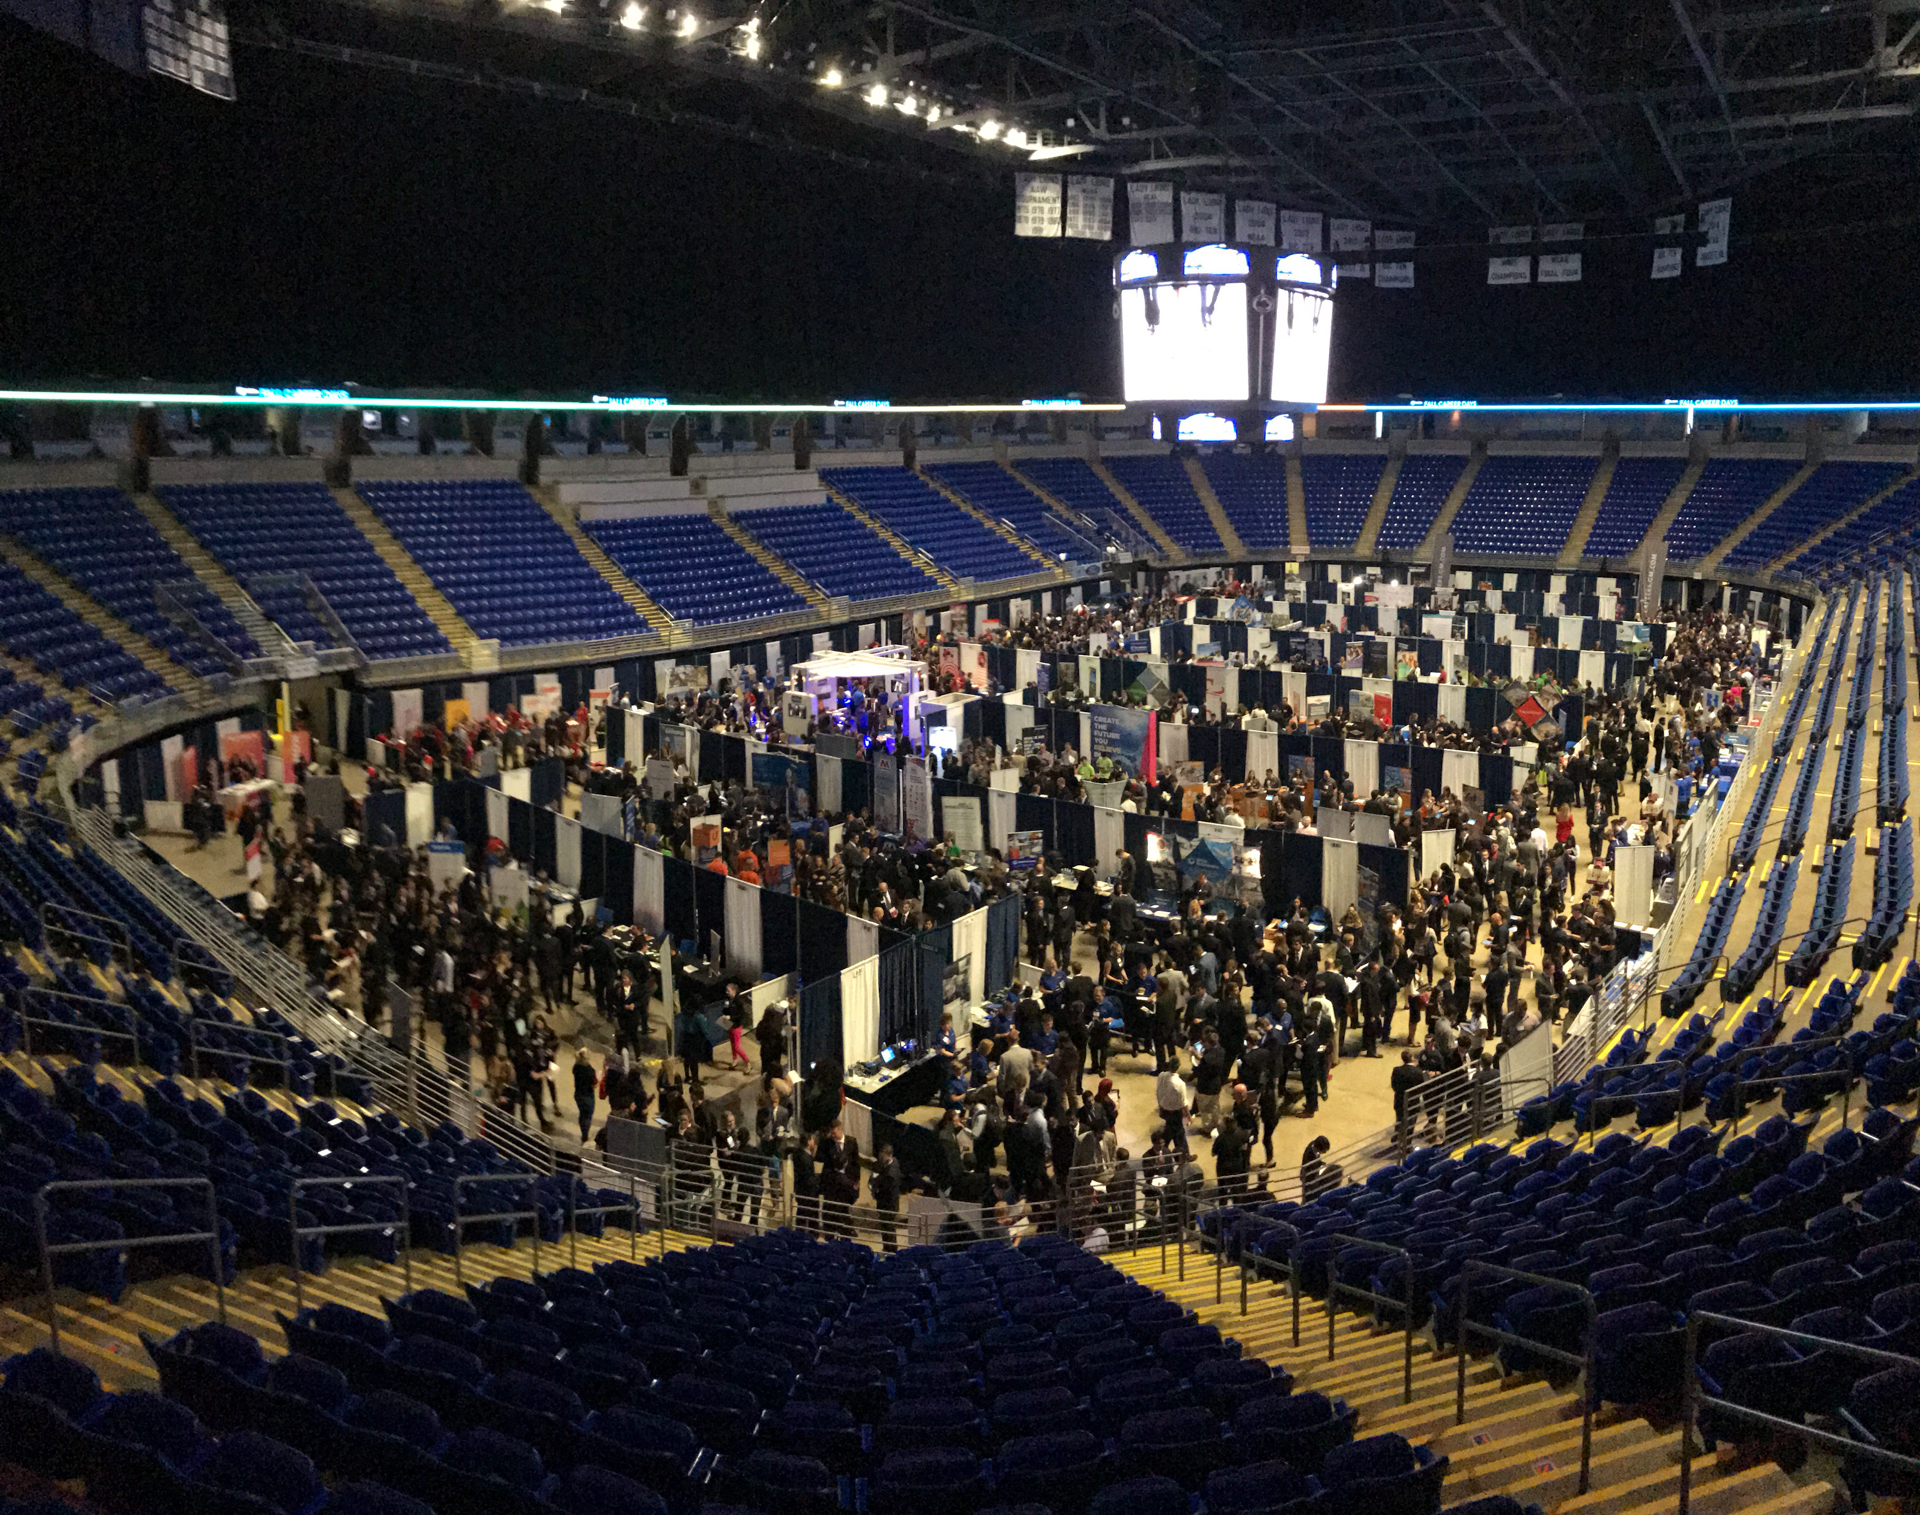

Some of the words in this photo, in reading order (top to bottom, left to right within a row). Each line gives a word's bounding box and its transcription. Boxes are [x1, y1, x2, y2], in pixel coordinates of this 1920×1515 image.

[1093, 715, 1120, 725] CREATE
[1093, 722, 1108, 731] THE
[1093, 730, 1120, 740] FUTURE
[1094, 737, 1109, 745] YOU
